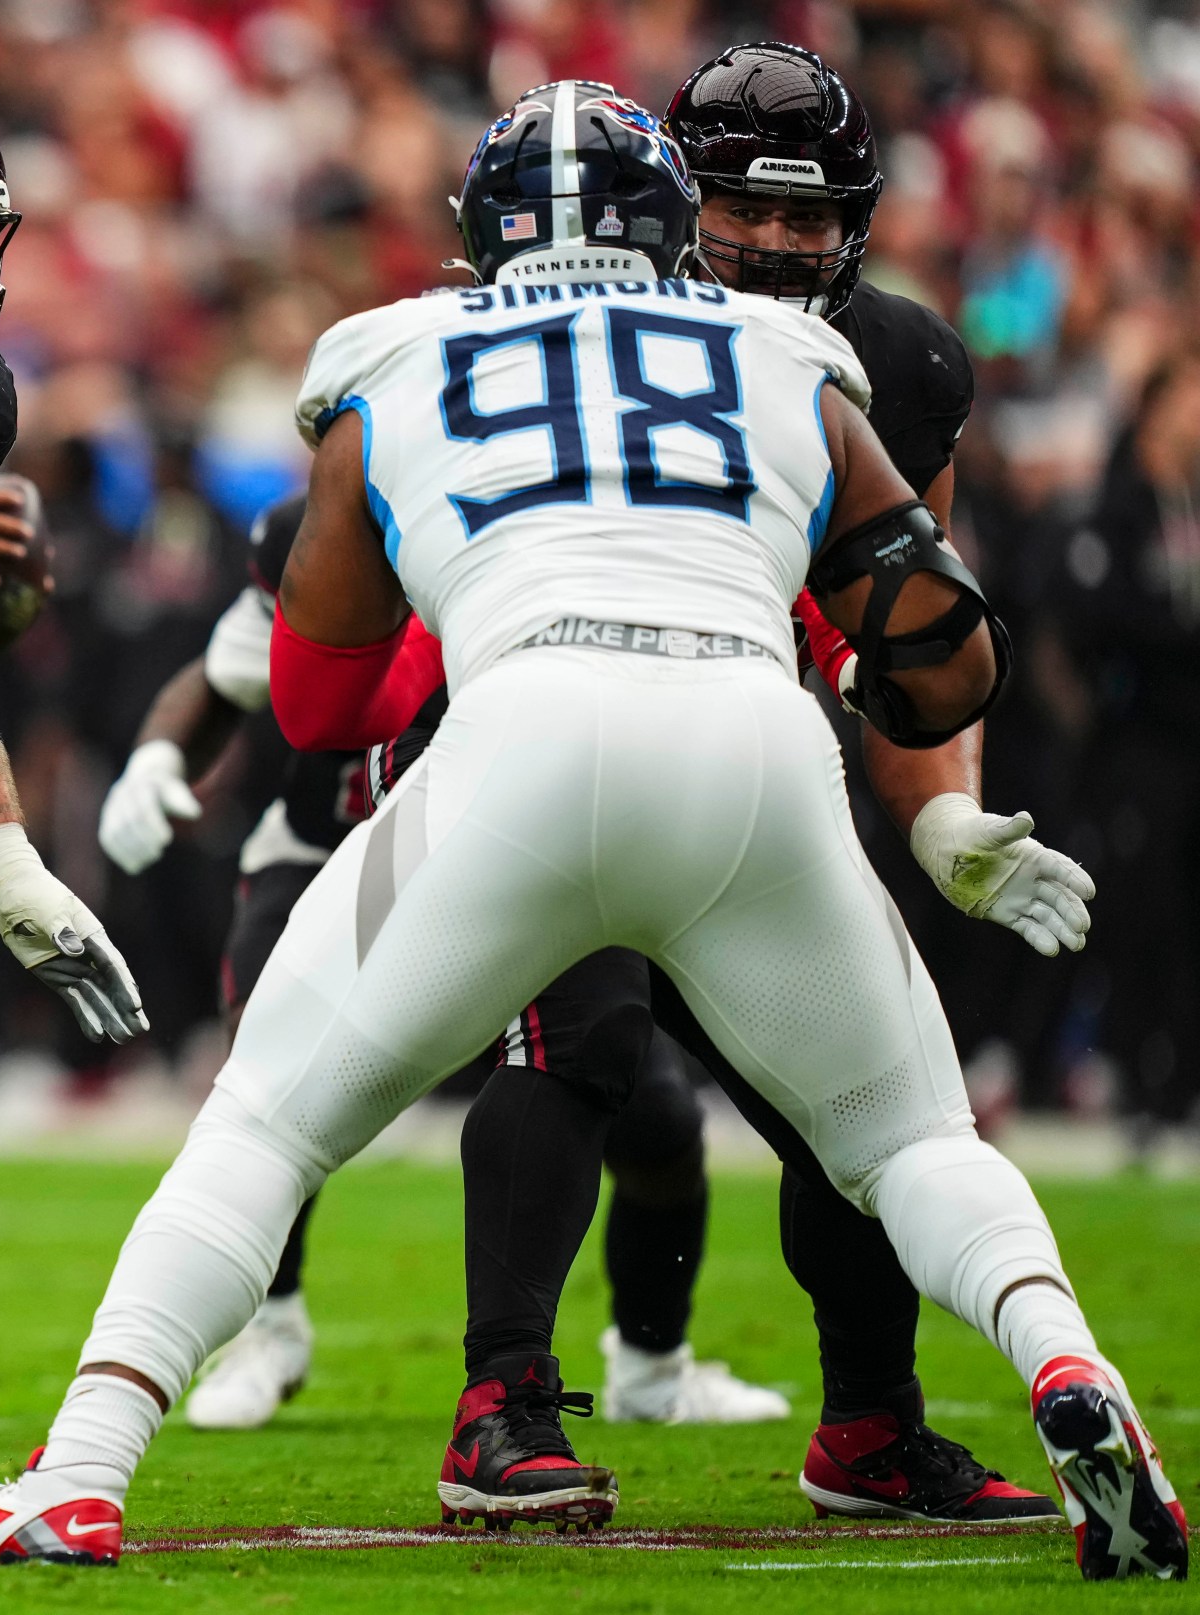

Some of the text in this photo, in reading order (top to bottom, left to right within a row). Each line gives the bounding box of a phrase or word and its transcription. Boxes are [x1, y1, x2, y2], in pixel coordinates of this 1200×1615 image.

[760, 162, 816, 175] ARIZONA
[512, 259, 632, 277] TENNESSEE
[458, 278, 729, 314] SIMMONS
[439, 304, 759, 542] 98
[533, 616, 626, 648] NIKE
